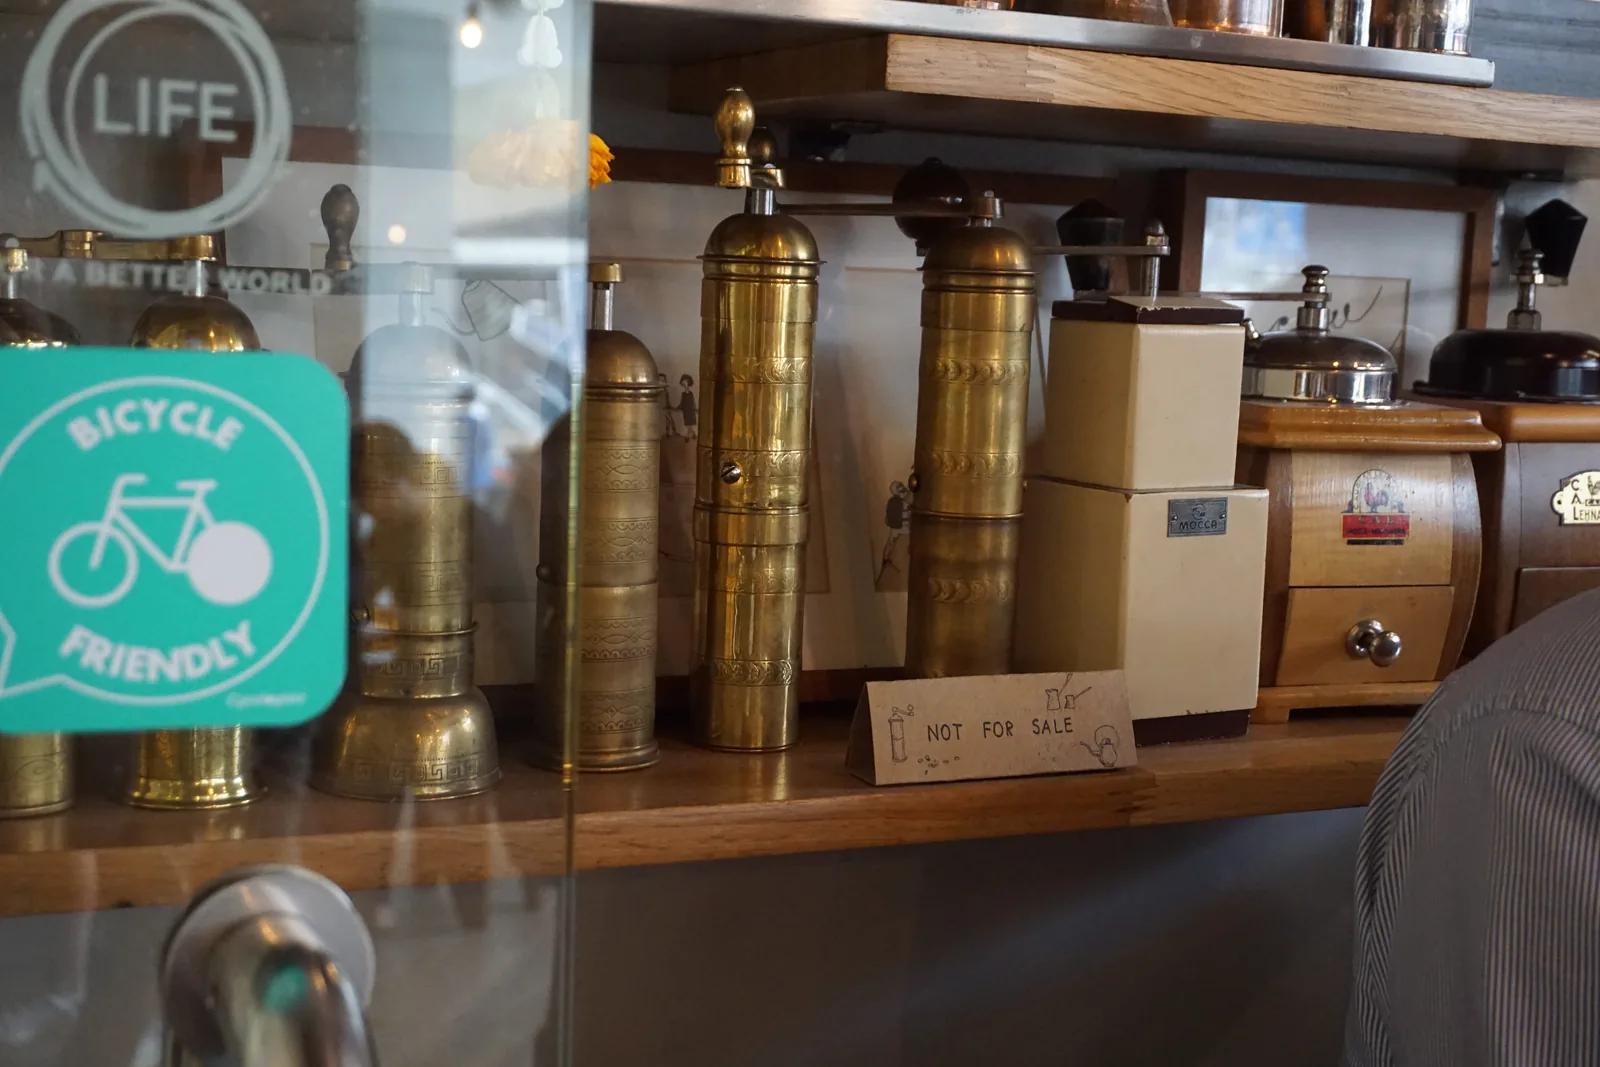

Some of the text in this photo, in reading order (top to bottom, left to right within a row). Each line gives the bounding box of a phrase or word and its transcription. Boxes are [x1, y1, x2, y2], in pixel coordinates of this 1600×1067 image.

[93, 71, 239, 142] LIFE
[218, 267, 333, 295] WORLD
[67, 398, 244, 451] BICYCLE
[1179, 520, 1217, 530] MOCCA
[59, 619, 256, 684] FRIENDLY
[927, 717, 1074, 742] NOT FOR SALE
